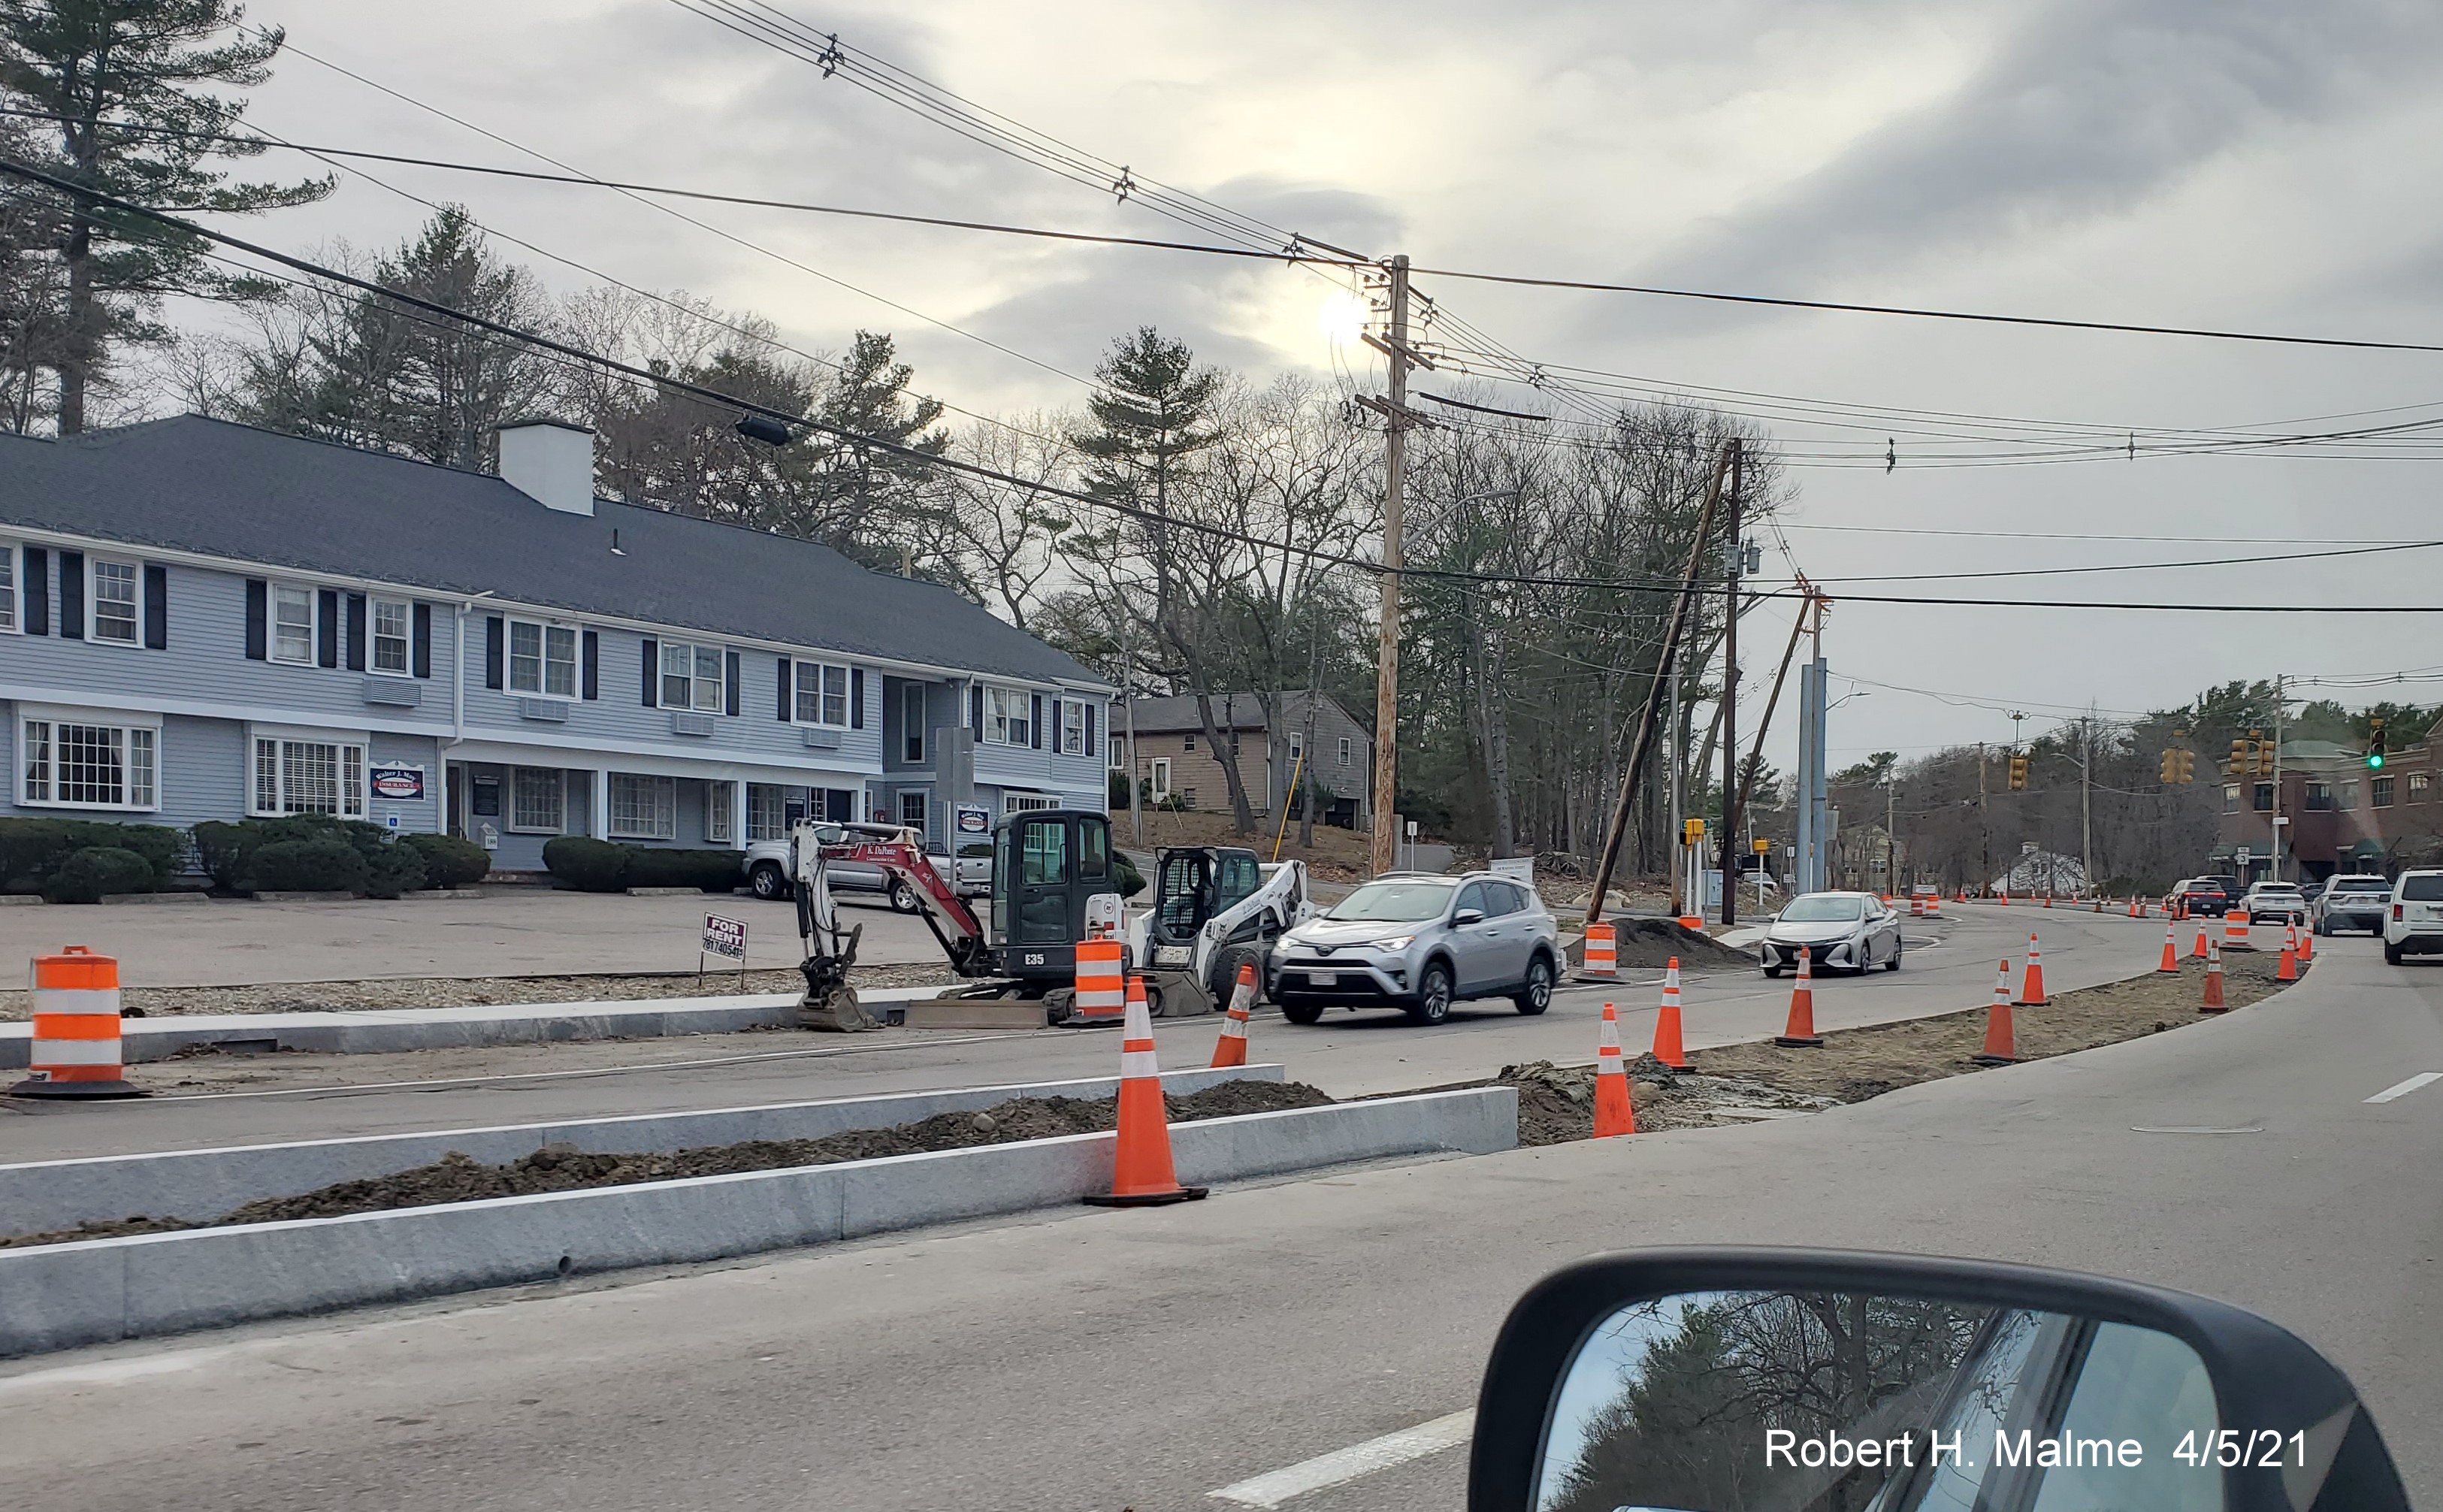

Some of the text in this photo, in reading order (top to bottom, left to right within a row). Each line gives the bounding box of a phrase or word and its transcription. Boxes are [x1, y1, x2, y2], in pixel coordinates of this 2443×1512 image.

[376, 771, 396, 779] Walter
[711, 918, 739, 934] FOR
[706, 927, 742, 945] RENT
[1024, 954, 1045, 965] E35
